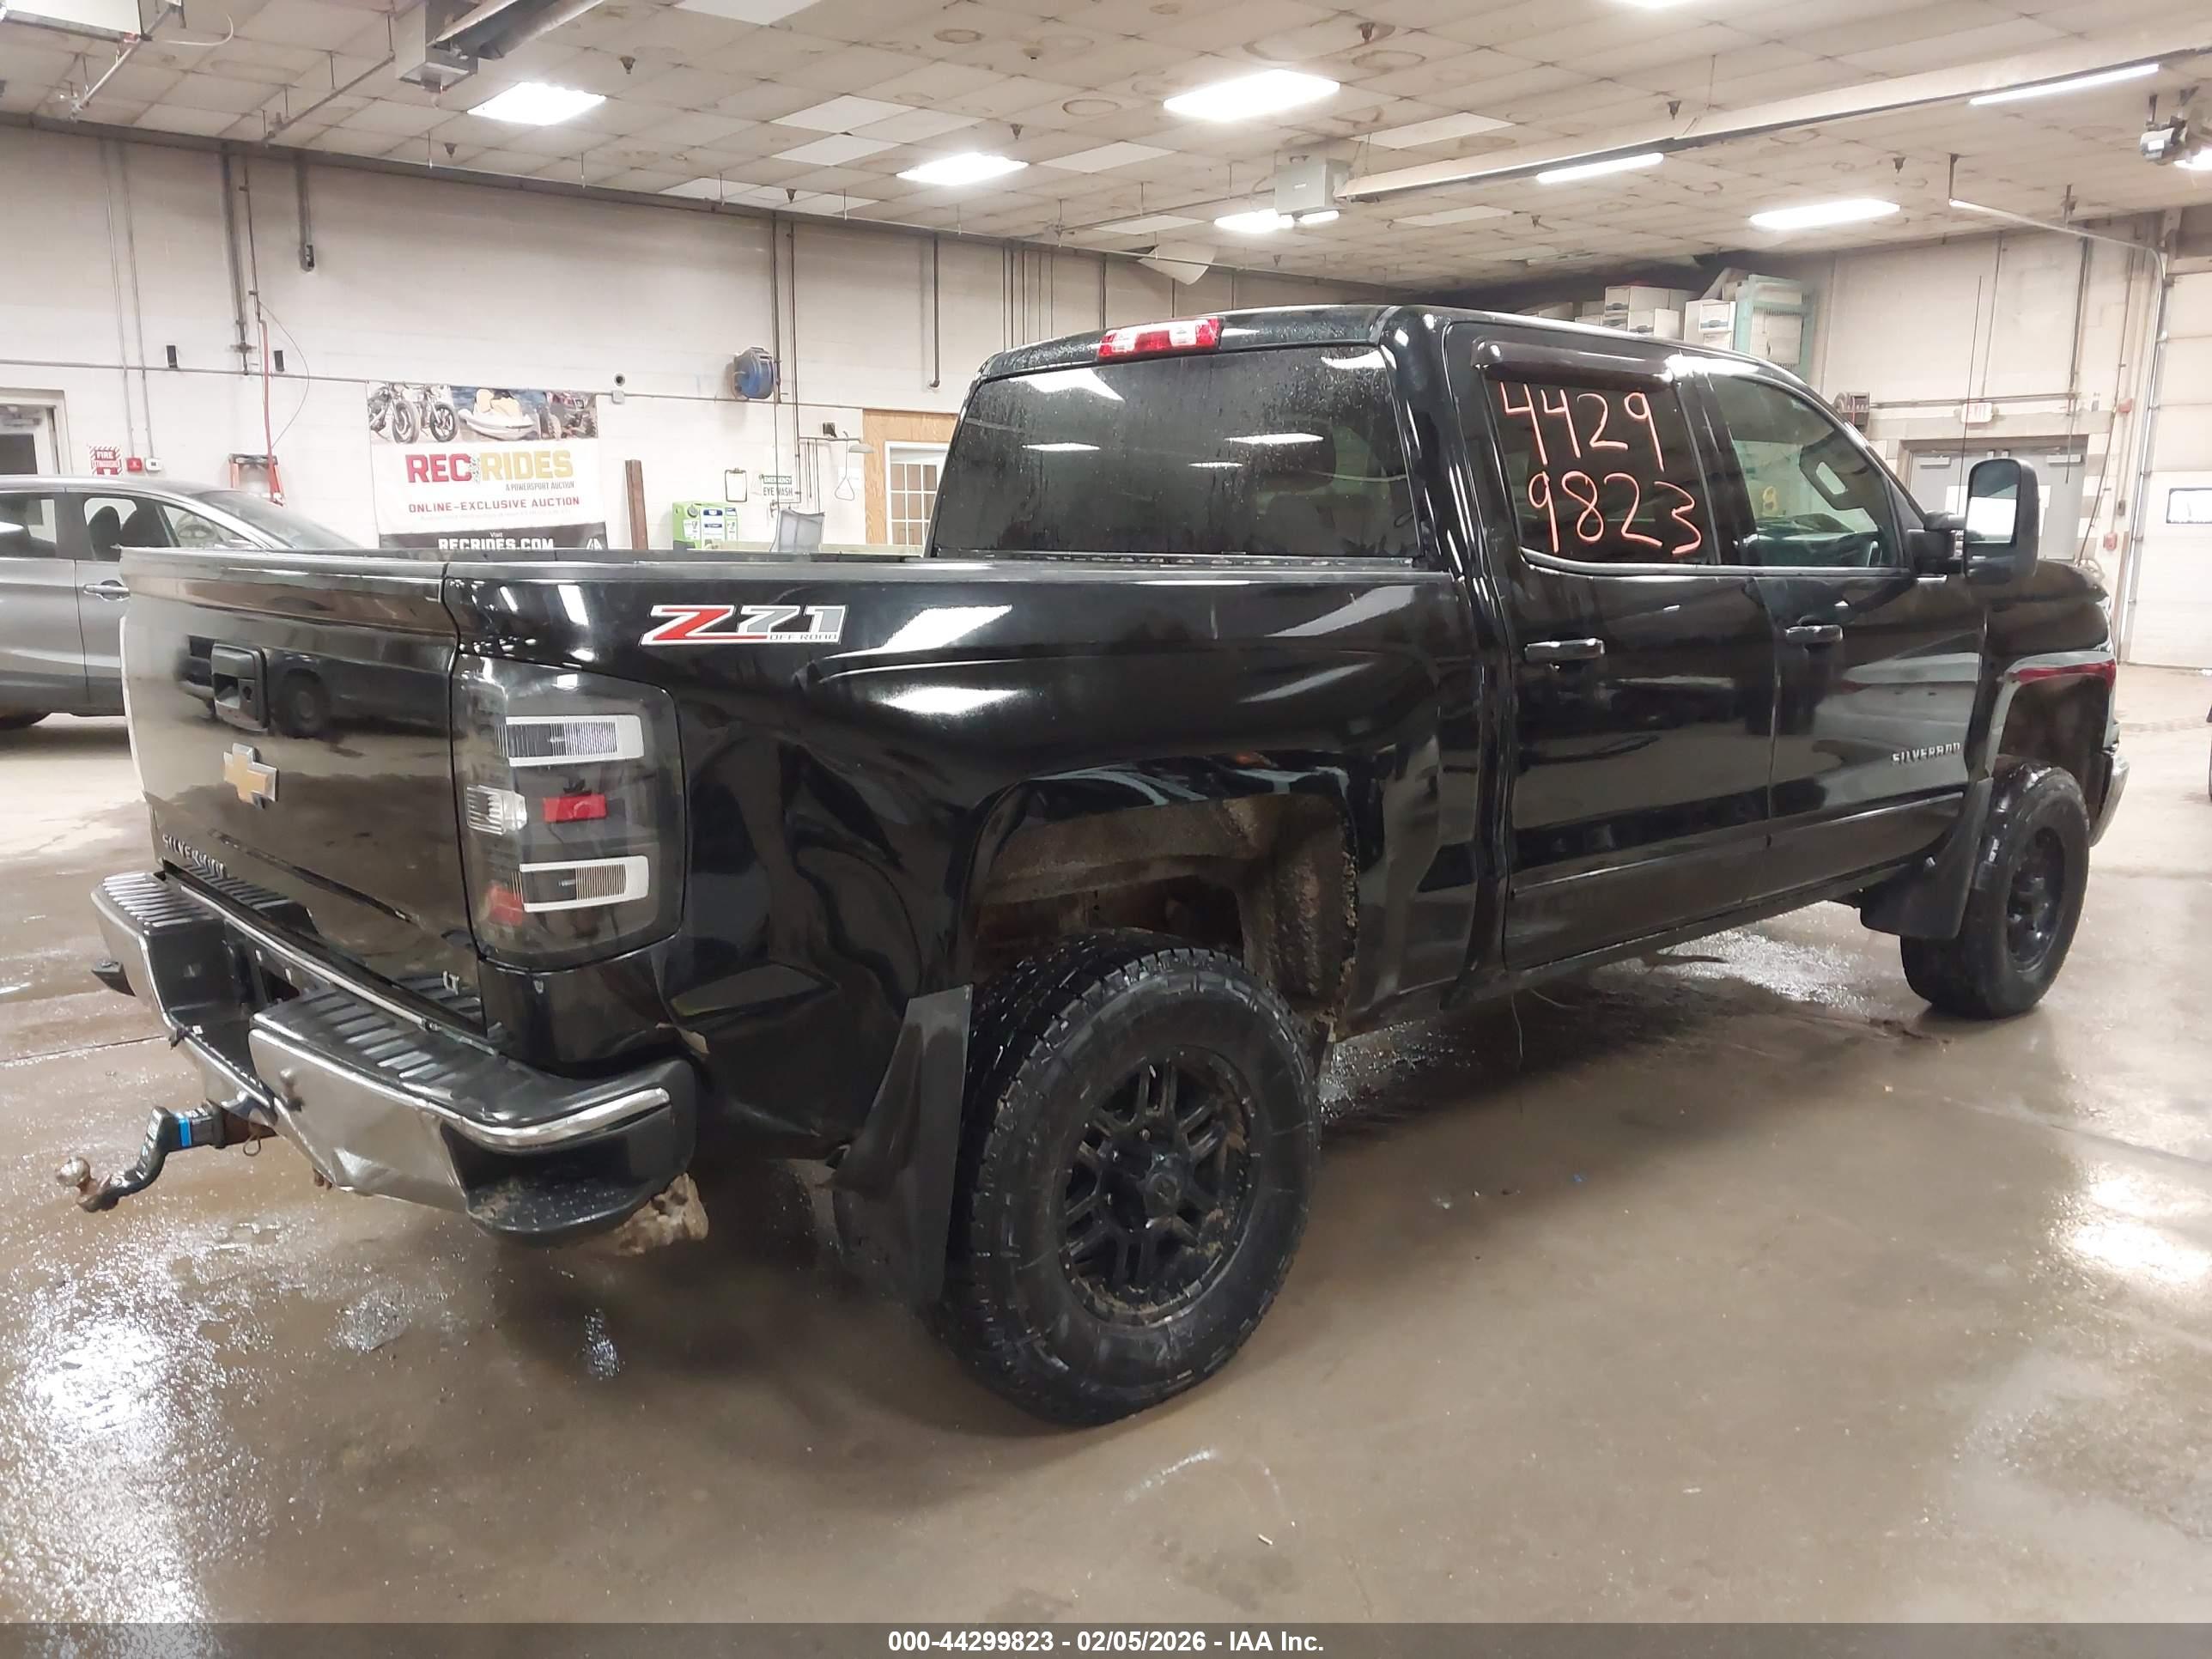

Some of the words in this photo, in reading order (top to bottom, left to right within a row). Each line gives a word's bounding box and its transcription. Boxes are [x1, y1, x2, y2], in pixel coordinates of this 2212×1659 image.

[1500, 382, 1664, 471] 4429
[96, 451, 113, 459] FIRE
[405, 453, 472, 483] REC
[480, 450, 574, 481] RIDES
[510, 482, 549, 491] POWERSPORT
[550, 481, 574, 489] AUCTION
[763, 487, 775, 496] EYE
[409, 499, 527, 513] ONLINE-EXCLUSIVE
[532, 497, 580, 507] AUCTION
[1528, 471, 1702, 554] 9823
[438, 537, 554, 550] RECRIDES.COM
[639, 605, 848, 645] Z71
[442, 970, 459, 995] LT
